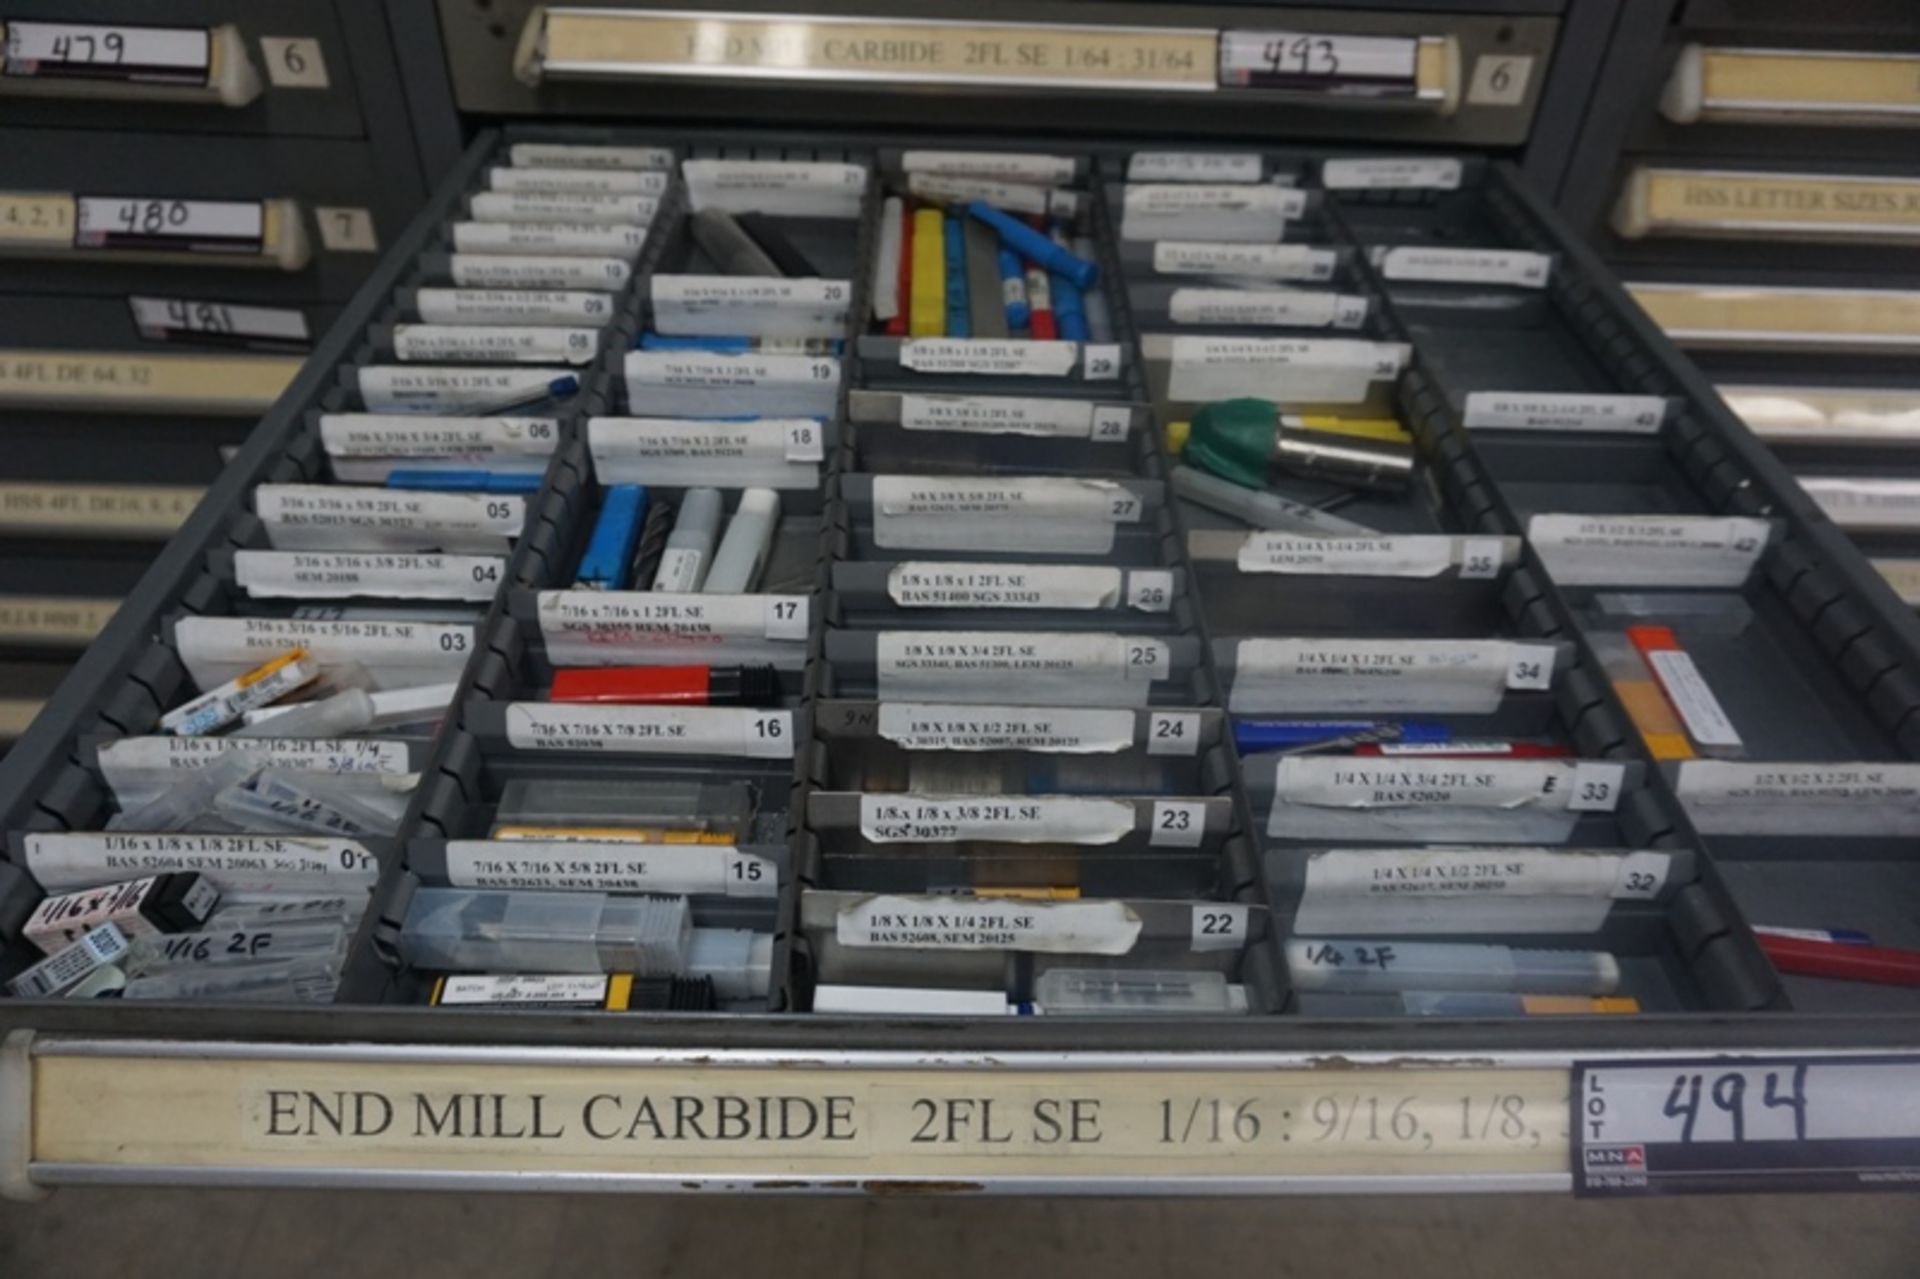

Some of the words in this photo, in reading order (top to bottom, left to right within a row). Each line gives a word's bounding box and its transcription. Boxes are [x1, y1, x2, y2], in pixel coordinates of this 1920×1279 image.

[50, 32, 125, 63] 479
[822, 38, 944, 64] CARBIDE
[964, 40, 1008, 65] 2FL
[1016, 42, 1050, 67] SE
[1063, 43, 1113, 69] 1/64
[1133, 47, 1194, 73] 31/64
[283, 42, 306, 75] 6
[1262, 38, 1340, 76] 493
[1489, 59, 1512, 94] 6
[1683, 184, 1730, 208] HSS
[1735, 186, 1826, 211] LETTER
[1833, 191, 1898, 214] SIZES
[117, 199, 189, 234] 480
[334, 211, 354, 241] 7
[824, 286, 842, 300] 20
[811, 364, 831, 379] 19
[529, 424, 550, 438] 06
[791, 429, 812, 445] 18
[487, 502, 511, 519] 05
[1112, 501, 1134, 514] 27
[1467, 557, 1492, 572] 35
[472, 566, 497, 582] 04
[901, 575, 920, 586] 1/8
[922, 578, 932, 586] x
[934, 575, 953, 587] 1/8
[956, 579, 966, 587] x
[978, 575, 1004, 587] 2FL
[1007, 575, 1025, 587] SE
[901, 591, 929, 602] BAS
[973, 591, 1000, 602] SGS
[1140, 588, 1164, 603] 26
[561, 604, 588, 617] 7/16
[591, 608, 599, 617] x
[603, 605, 630, 617] 7/16
[633, 608, 641, 618] x
[654, 606, 683, 618] 2FL
[684, 606, 705, 618] SE
[774, 603, 797, 619] 17
[364, 625, 393, 637] 2FL
[395, 626, 414, 638] SE
[440, 633, 466, 651] 03
[1132, 648, 1156, 665] 25
[1516, 663, 1540, 679] 34
[530, 722, 557, 735] 7/16
[559, 723, 570, 735] X
[574, 723, 600, 736] 7/16
[602, 724, 614, 735] X
[616, 724, 636, 736] 7/8
[638, 725, 665, 737] 2FL
[667, 725, 687, 737] SE
[755, 719, 781, 737] 16
[910, 721, 929, 733] 1/8
[931, 722, 943, 733] X
[946, 722, 966, 734] 1/8
[968, 723, 980, 734] X
[983, 722, 1002, 734] 1/2
[1005, 723, 1032, 734] 2FL
[1034, 723, 1052, 734] SE
[1156, 720, 1184, 738] 24
[1334, 771, 1355, 785] 1/4
[1356, 771, 1371, 785] X
[1375, 772, 1398, 786] 1/4
[1401, 773, 1413, 786] X
[1415, 773, 1437, 787] 3/4
[1440, 774, 1471, 787] 2FL
[1474, 775, 1497, 787] SE
[1541, 776, 1557, 794] E
[1581, 784, 1609, 800] 33
[915, 806, 938, 822] 1/8
[943, 811, 954, 822] x
[955, 806, 980, 822] 3/8
[982, 806, 1014, 822] 2FL
[1018, 806, 1040, 822] SE
[1161, 810, 1190, 830] 23
[874, 825, 907, 838] SGS
[911, 826, 957, 838] 30377
[105, 836, 139, 851] 1/16
[142, 840, 152, 851] x
[156, 837, 182, 851] 1/8
[185, 841, 194, 852] x
[199, 838, 222, 852] 1/8
[227, 838, 260, 852] 2FL
[264, 839, 287, 853] SE
[106, 855, 138, 869] BAS
[187, 856, 222, 870] SEM
[473, 860, 505, 875] 7/16
[506, 861, 519, 874] X
[521, 861, 550, 875] 7/16
[553, 861, 566, 874] X
[569, 861, 592, 875] 5/8
[594, 861, 624, 875] 2FL
[626, 861, 648, 875] SE
[732, 861, 762, 880] 15
[1625, 872, 1656, 892] 32
[870, 914, 893, 929] 1/8
[895, 915, 910, 929] X
[913, 915, 935, 929] 1/8
[937, 915, 952, 929] X
[954, 915, 976, 929] 1/4
[978, 915, 1010, 930] 2FL
[1012, 916, 1034, 930] SE
[1201, 913, 1233, 935] 22
[165, 936, 210, 960] 1/16
[226, 933, 272, 955] 2F
[869, 932, 899, 943] BAS
[940, 932, 975, 944] SEM
[978, 932, 1016, 945] 20125
[1354, 945, 1396, 970] 2F
[1588, 1074, 1606, 1140] LOT
[1662, 1064, 1808, 1142] 494
[265, 1089, 394, 1138] END
[412, 1092, 566, 1140] MILL
[581, 1093, 858, 1142] CARBIDE
[909, 1098, 1015, 1144] 2FL
[1032, 1098, 1104, 1145] SE
[1157, 1096, 1262, 1145] 1/16
[1281, 1105, 1292, 1144] :
[1310, 1093, 1435, 1150] 9/16,
[1457, 1093, 1543, 1150] 1/8,
[1588, 1148, 1643, 1163] MNA
